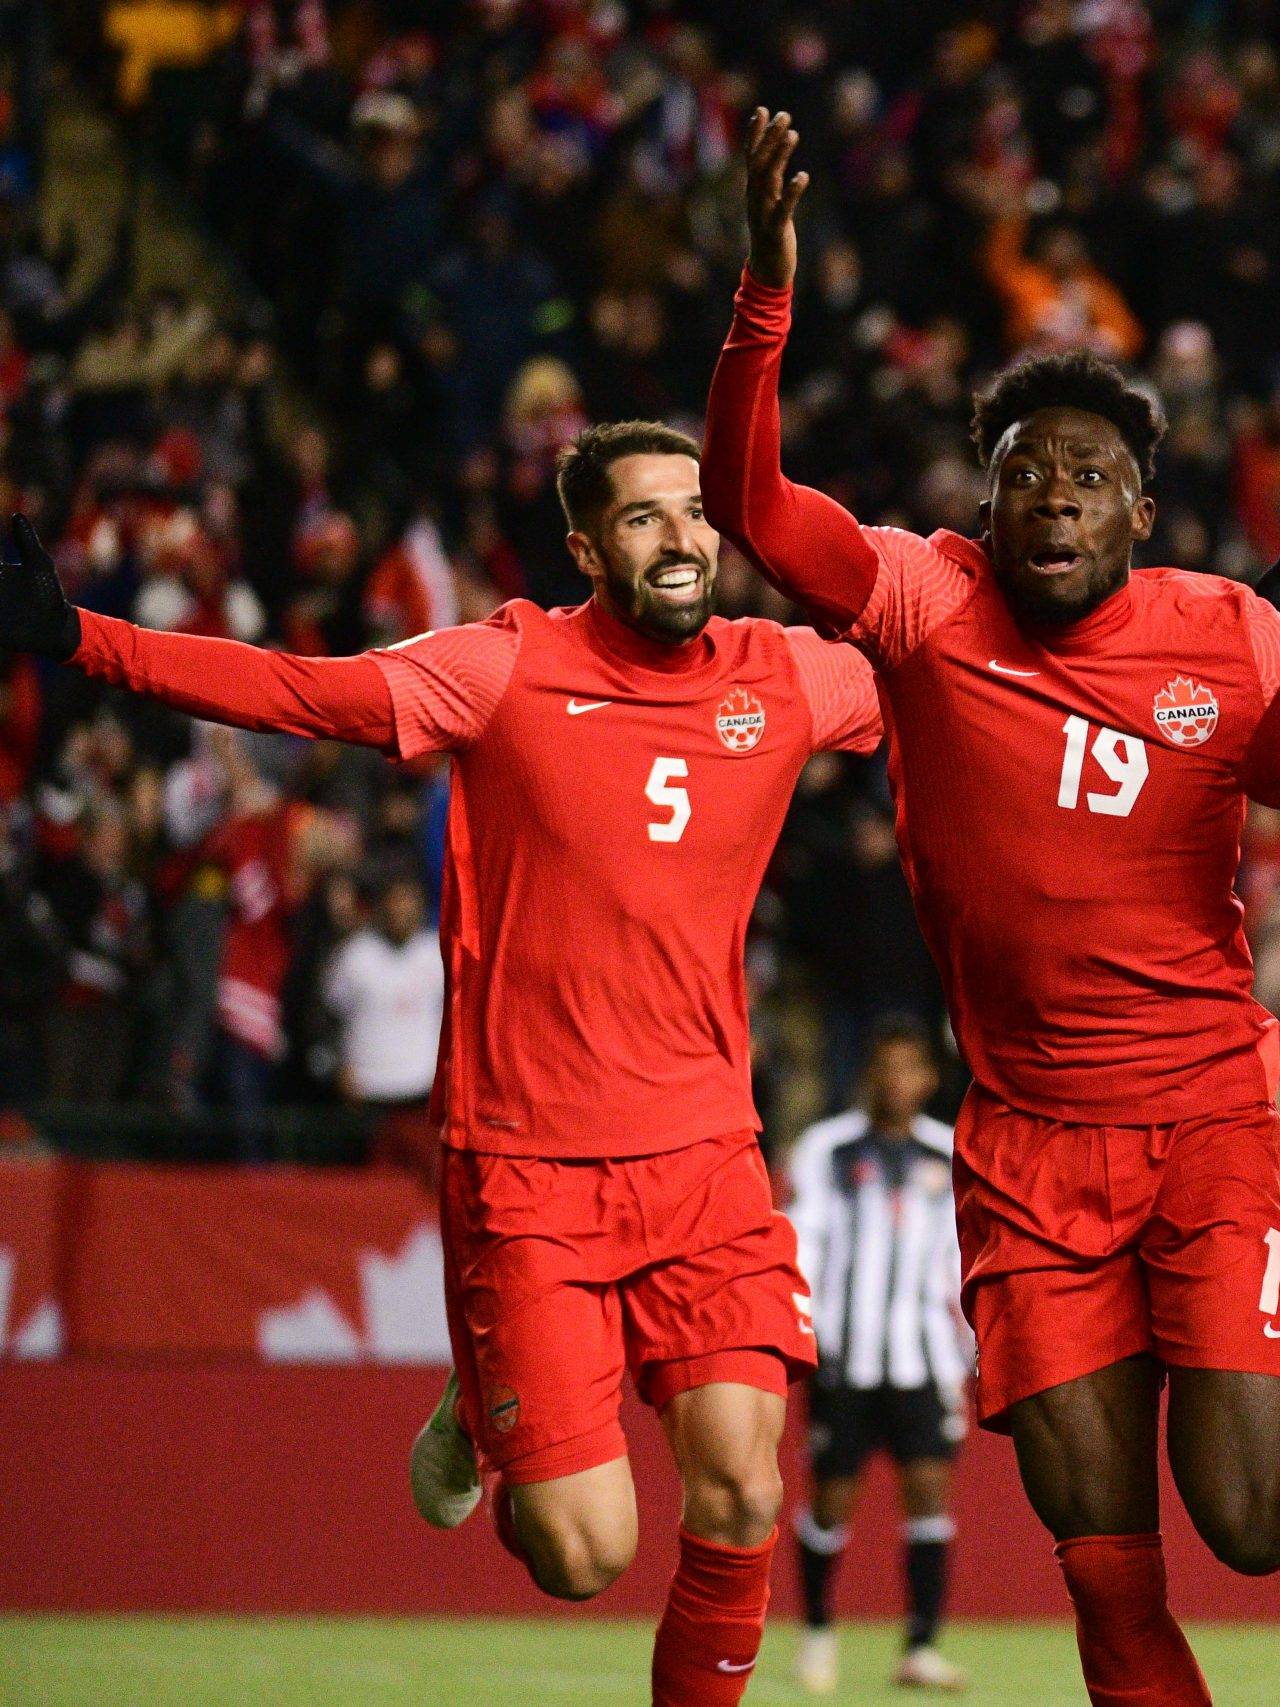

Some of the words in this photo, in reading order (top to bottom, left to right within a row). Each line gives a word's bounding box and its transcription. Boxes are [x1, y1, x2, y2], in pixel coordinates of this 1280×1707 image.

[718, 716, 763, 727] CANADA
[1156, 706, 1216, 721] CANADA
[1057, 714, 1150, 818] 19
[644, 756, 692, 843] 5
